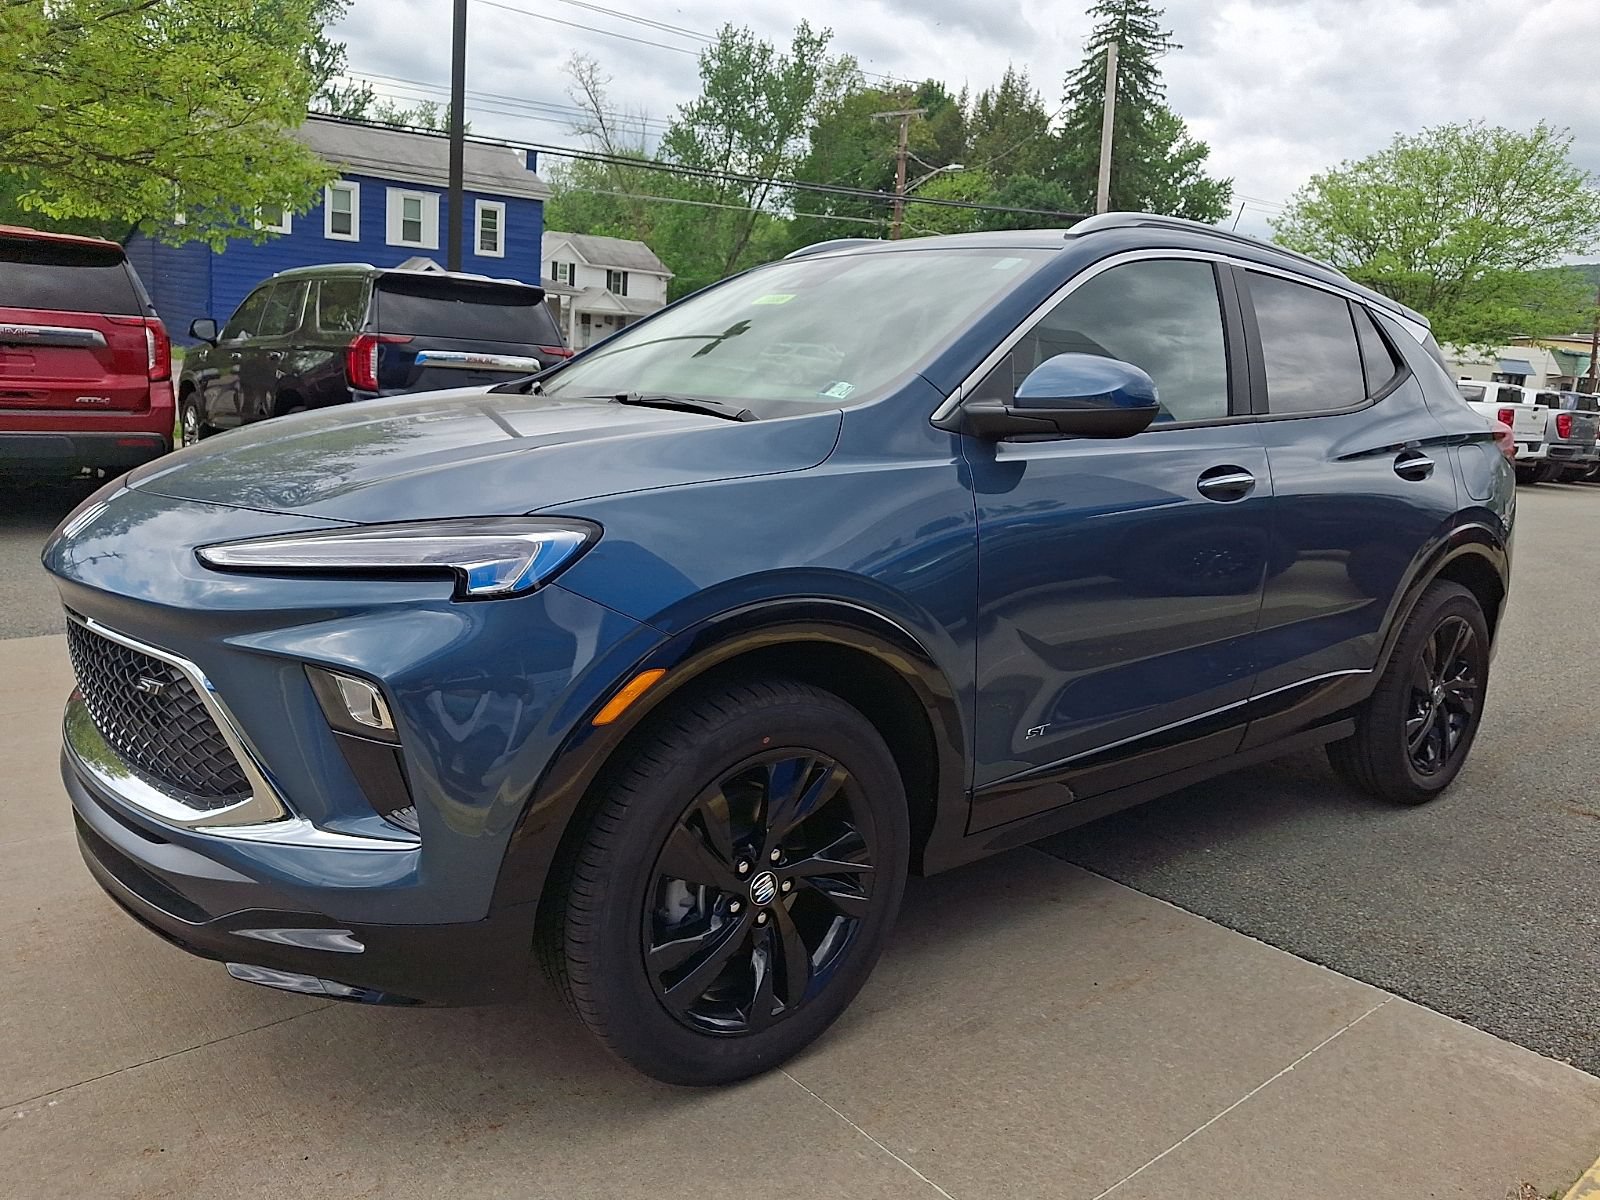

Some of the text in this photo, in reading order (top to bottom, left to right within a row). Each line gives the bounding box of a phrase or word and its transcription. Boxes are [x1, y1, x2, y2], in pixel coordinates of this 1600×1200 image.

[0, 327, 40, 337] MC
[136, 676, 164, 695] ST
[1025, 722, 1051, 740] ST
